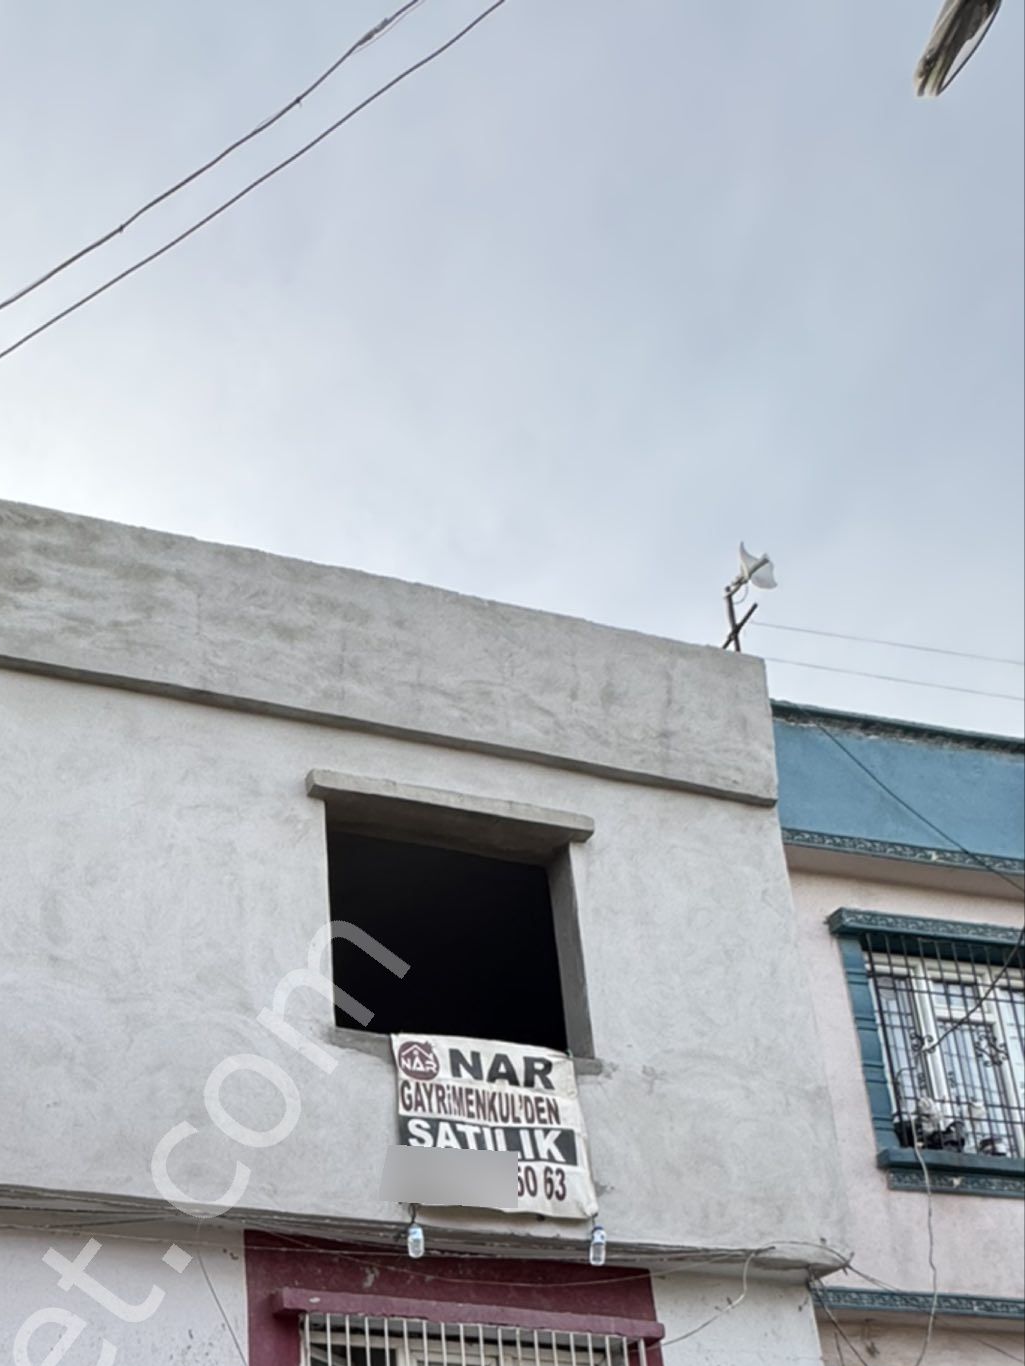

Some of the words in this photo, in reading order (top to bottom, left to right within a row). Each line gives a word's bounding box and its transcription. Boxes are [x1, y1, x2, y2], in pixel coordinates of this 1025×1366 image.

[401, 1056, 437, 1073] NAR
[448, 1048, 555, 1090] NAR
[543, 1166, 567, 1201] 63
